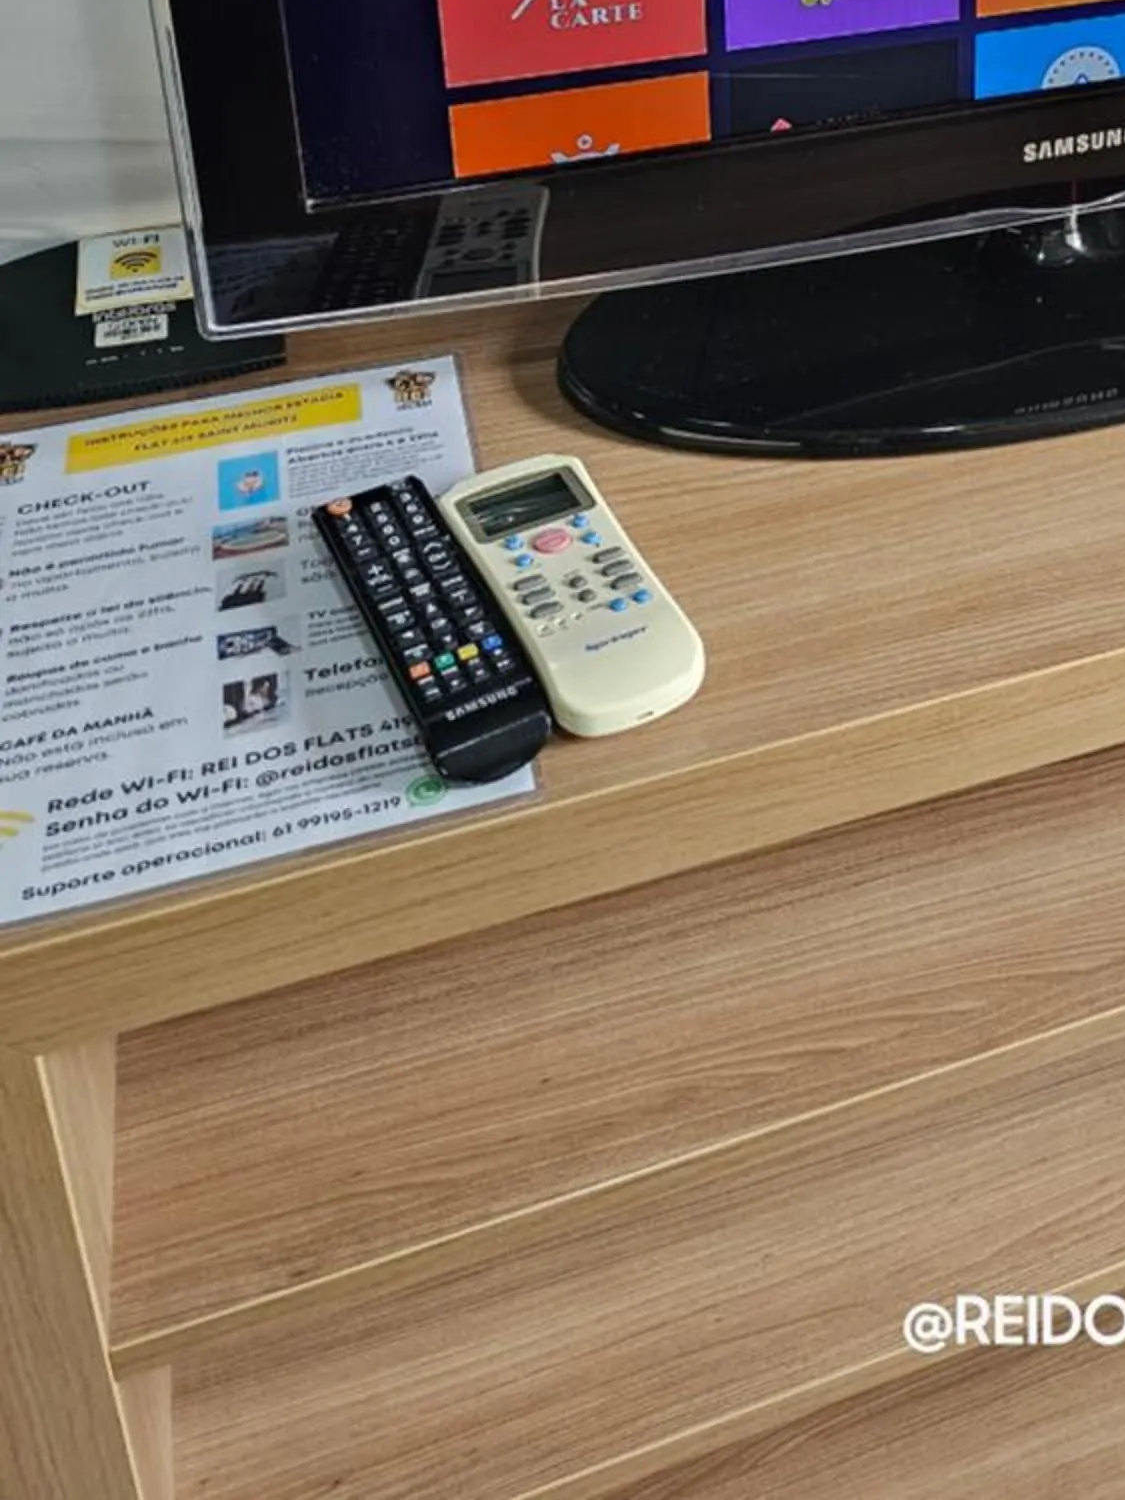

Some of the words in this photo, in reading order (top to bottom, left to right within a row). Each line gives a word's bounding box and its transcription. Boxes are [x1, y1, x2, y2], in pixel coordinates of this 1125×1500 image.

[550, 1, 643, 30] CARTE
[17, 481, 151, 515] CHECK-OUT
[446, 684, 517, 721] SAMSUNG
[0, 730, 47, 752] CAFÉ
[51, 725, 78, 741] DA
[82, 706, 154, 733] MANHÃ
[47, 787, 114, 814] Rede
[120, 768, 194, 795] WI-FI:
[201, 755, 238, 777] REI
[245, 741, 298, 766] DOS
[303, 722, 374, 752] FLATS
[46, 807, 129, 837] Senha
[135, 798, 170, 814] do
[176, 776, 249, 804] WI-FI:
[22, 869, 115, 901] Suporte
[121, 830, 267, 877] operacional:
[272, 821, 293, 838] 61
[297, 794, 402, 830] 99195-1219
